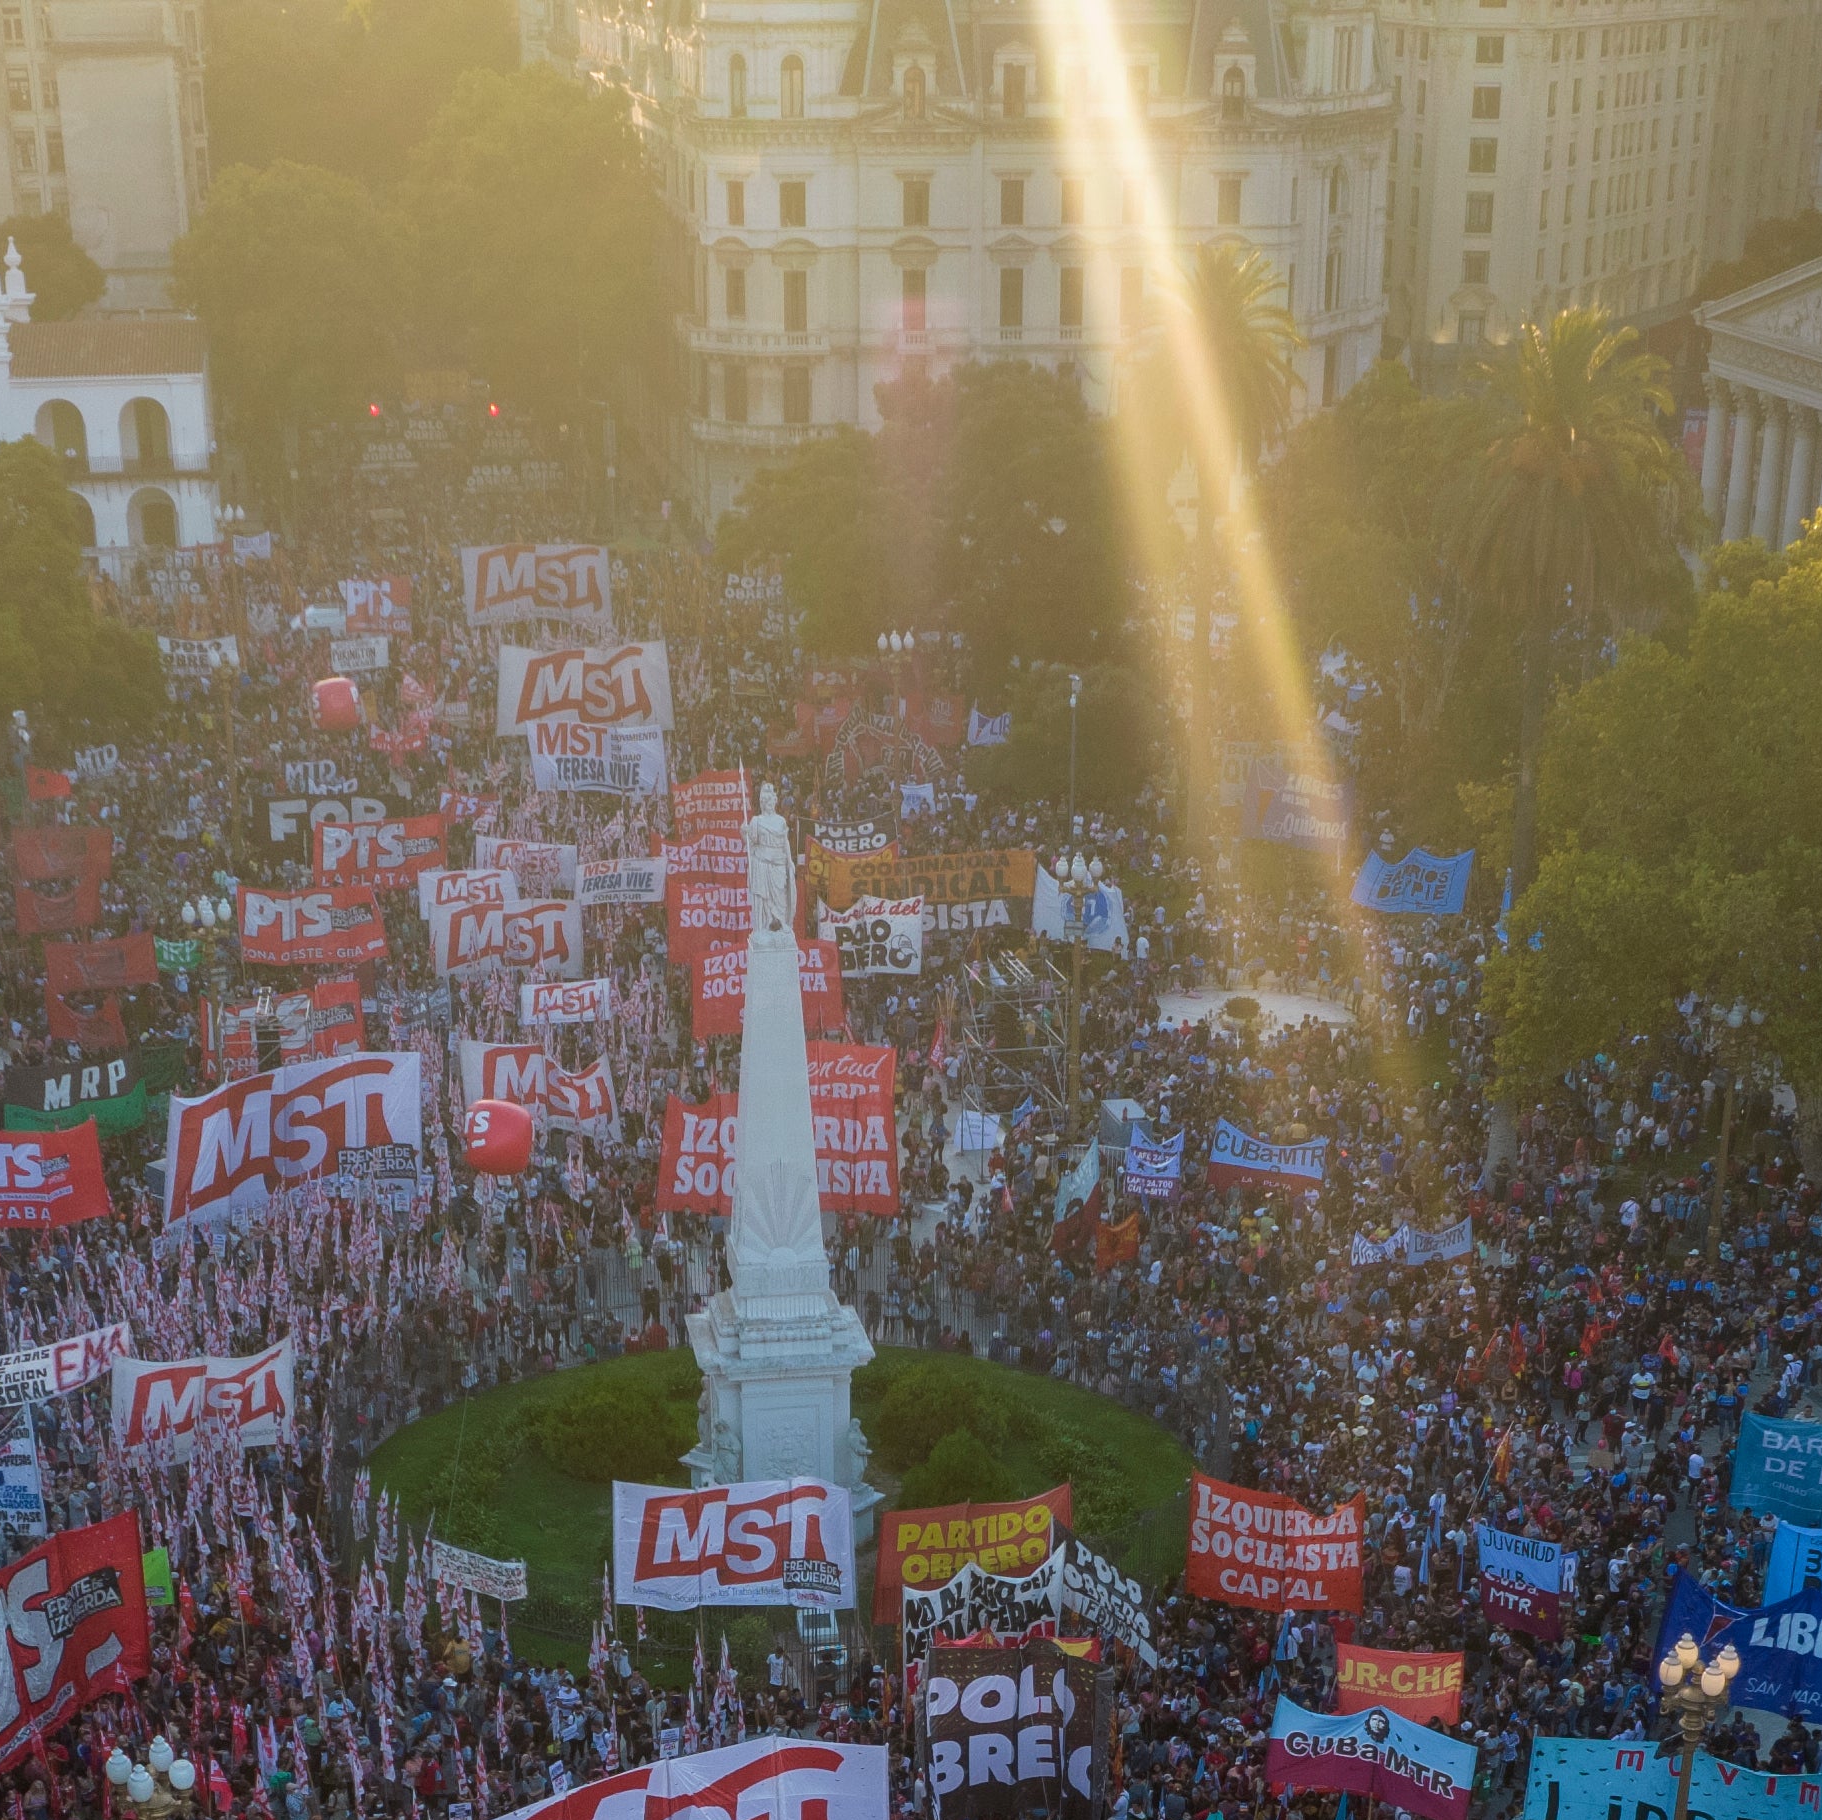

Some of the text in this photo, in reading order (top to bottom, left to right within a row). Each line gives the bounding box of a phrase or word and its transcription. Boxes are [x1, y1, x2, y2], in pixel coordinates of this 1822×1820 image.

[486, 551, 598, 600] MST
[351, 578, 390, 616] PTS
[531, 658, 646, 719] MST
[537, 723, 607, 755] MST
[556, 759, 640, 787] TERESA VIVE
[814, 821, 875, 837] POLO
[322, 824, 406, 871] PTS
[582, 873, 652, 891] TERESA VIVE
[584, 862, 622, 877] MST
[852, 869, 1010, 901] SINDICAL
[441, 875, 501, 902] MST
[243, 891, 332, 941] PTS
[890, 899, 920, 915] del
[458, 904, 564, 962] MST
[836, 920, 892, 945] POLO
[281, 949, 323, 960] OESTE
[534, 985, 595, 1014] MST
[43, 1059, 127, 1111] MRP
[495, 1053, 609, 1117] MST
[191, 1080, 390, 1193] MST
[338, 1146, 395, 1166] FRENTE
[144, 1369, 277, 1433] MST
[1764, 1455, 1805, 1477] DE
[1196, 1483, 1358, 1537] IZQUIERDA
[652, 1496, 827, 1575] MST
[897, 1505, 1052, 1553] PARTIDO
[1191, 1517, 1360, 1572] SOCIALISTA
[1483, 1526, 1556, 1564] JUVENTUD
[784, 1560, 827, 1573] FRENTE
[784, 1571, 841, 1588] IZQUIERDA
[1075, 1541, 1143, 1603] POLO
[47, 1584, 121, 1639] IZQUIERDA
[1391, 1660, 1462, 1692] CHE
[1745, 1675, 1781, 1697] SAN
